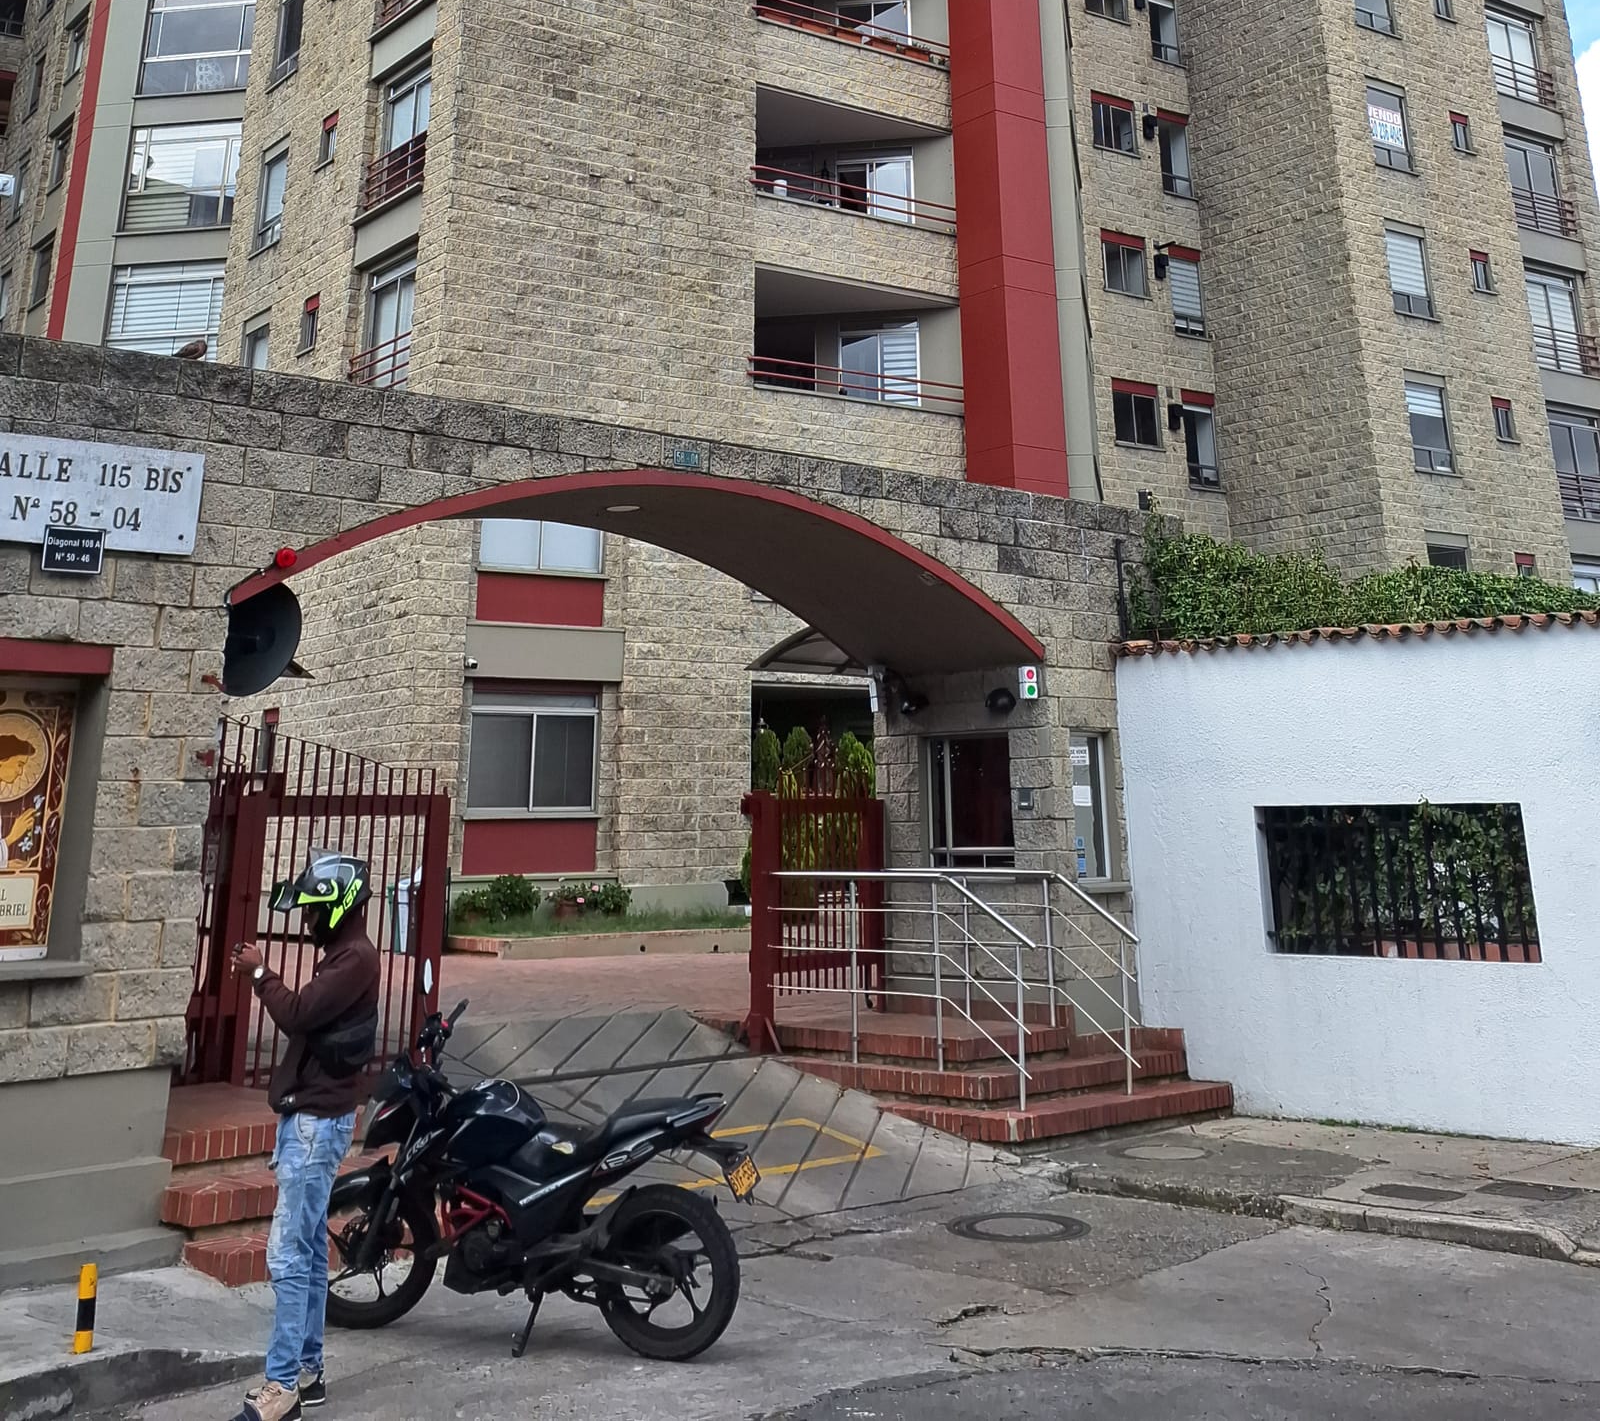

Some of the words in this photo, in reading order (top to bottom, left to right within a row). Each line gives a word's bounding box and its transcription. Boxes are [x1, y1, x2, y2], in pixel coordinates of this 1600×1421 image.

[99, 463, 132, 488] 115
[143, 467, 184, 493] BIS
[49, 500, 78, 525] 58
[113, 507, 141, 531] 04
[47, 536, 80, 547] Diagonal
[94, 540, 101, 549] A
